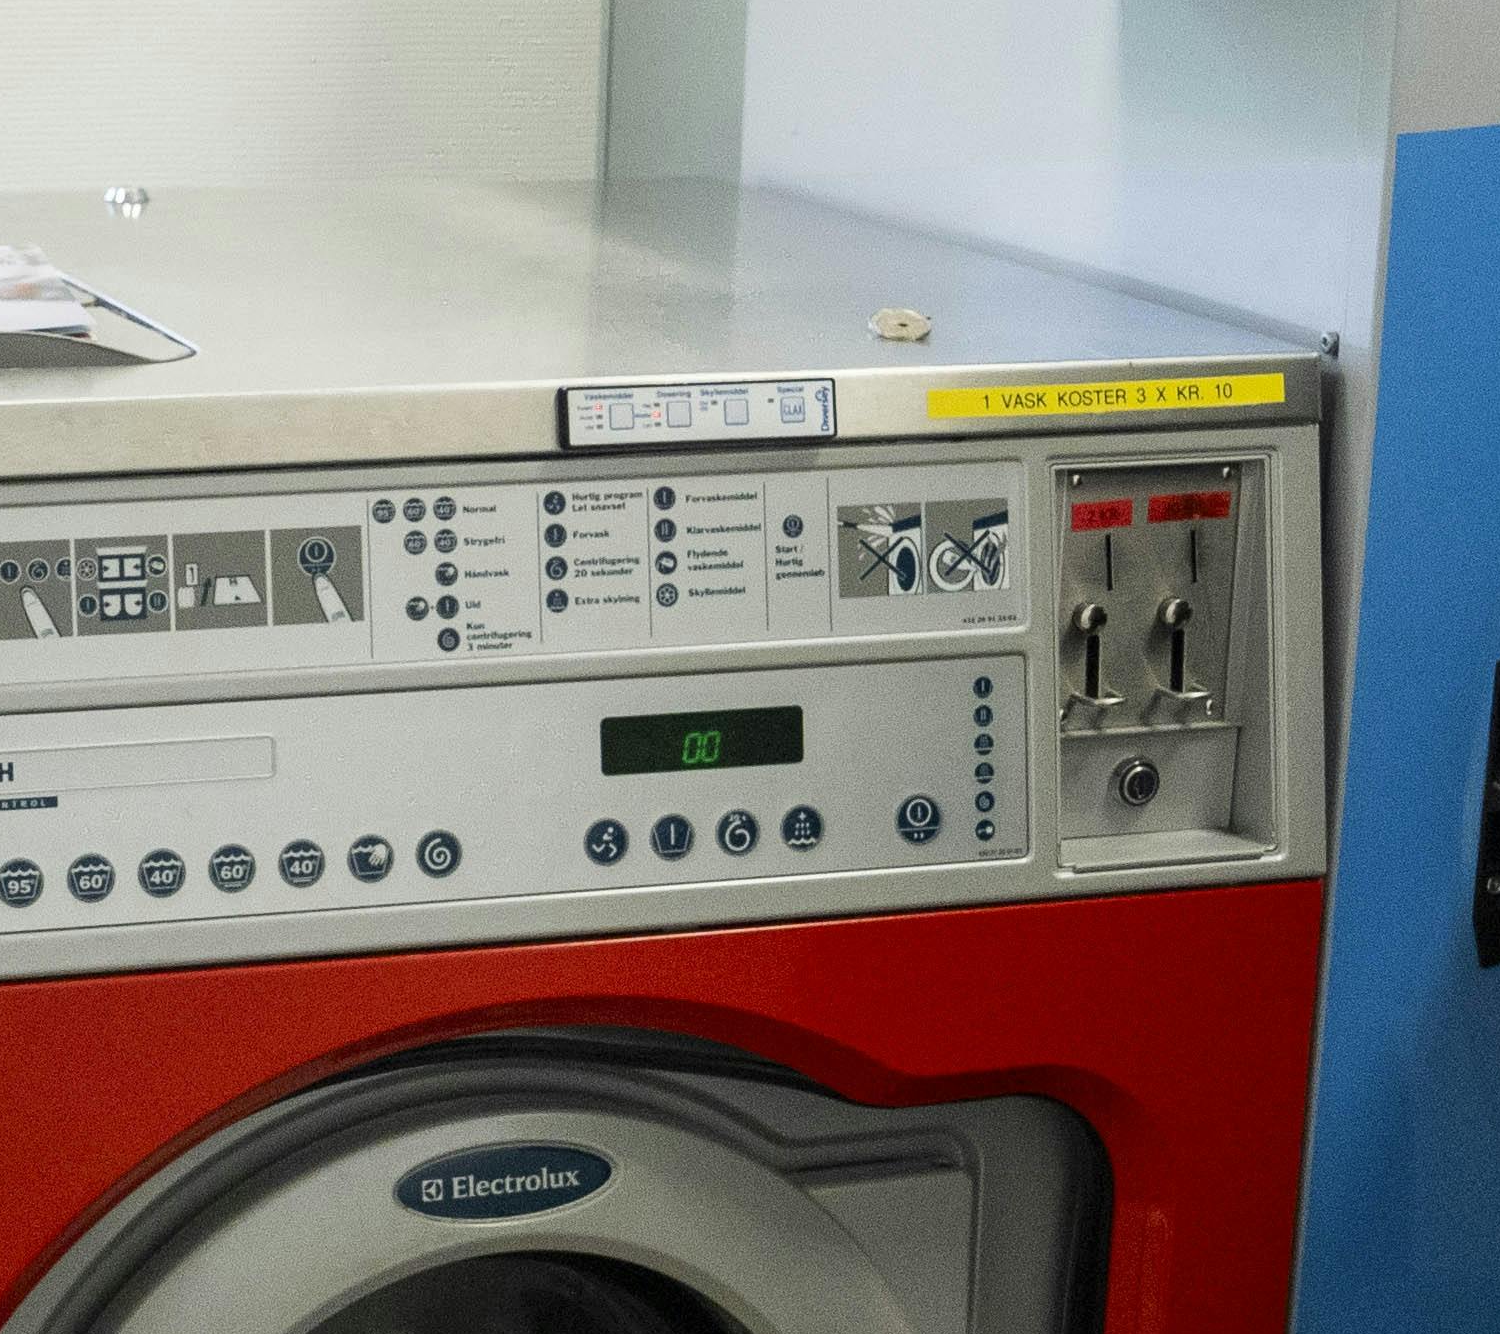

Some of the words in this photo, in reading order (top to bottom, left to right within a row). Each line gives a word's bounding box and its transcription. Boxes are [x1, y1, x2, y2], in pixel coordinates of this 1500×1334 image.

[777, 386, 804, 394] Special
[984, 395, 989, 409] 1
[1001, 392, 1046, 408] VASK
[1057, 389, 1126, 406] KOSTER
[1136, 388, 1146, 402] 3
[1157, 387, 1166, 402] X
[1177, 385, 1203, 400] KR.
[1215, 382, 1232, 399] 10
[572, 493, 601, 501] Hurtig
[604, 492, 643, 500] program
[686, 492, 757, 503] Forvaskemiddel
[463, 505, 496, 513] Normal
[572, 504, 587, 512] Let
[591, 503, 626, 511] snavset
[687, 523, 761, 535] Klarvaskemiddel
[573, 530, 609, 539] Forvask
[464, 536, 505, 546] Strygefri
[687, 549, 728, 559] Flydende
[775, 545, 797, 554] Start
[574, 557, 640, 567] Centrifugering
[688, 560, 744, 571] vaskemiddel
[775, 558, 803, 567] Hurtig
[575, 569, 587, 578] 20
[591, 568, 633, 577] sekunder
[465, 601, 481, 609] Uld
[575, 596, 599, 605] Extra
[603, 595, 640, 605] skylning
[466, 630, 532, 641] centrifugering
[682, 731, 721, 763] 00
[452, 1167, 580, 1199] Electrolux
